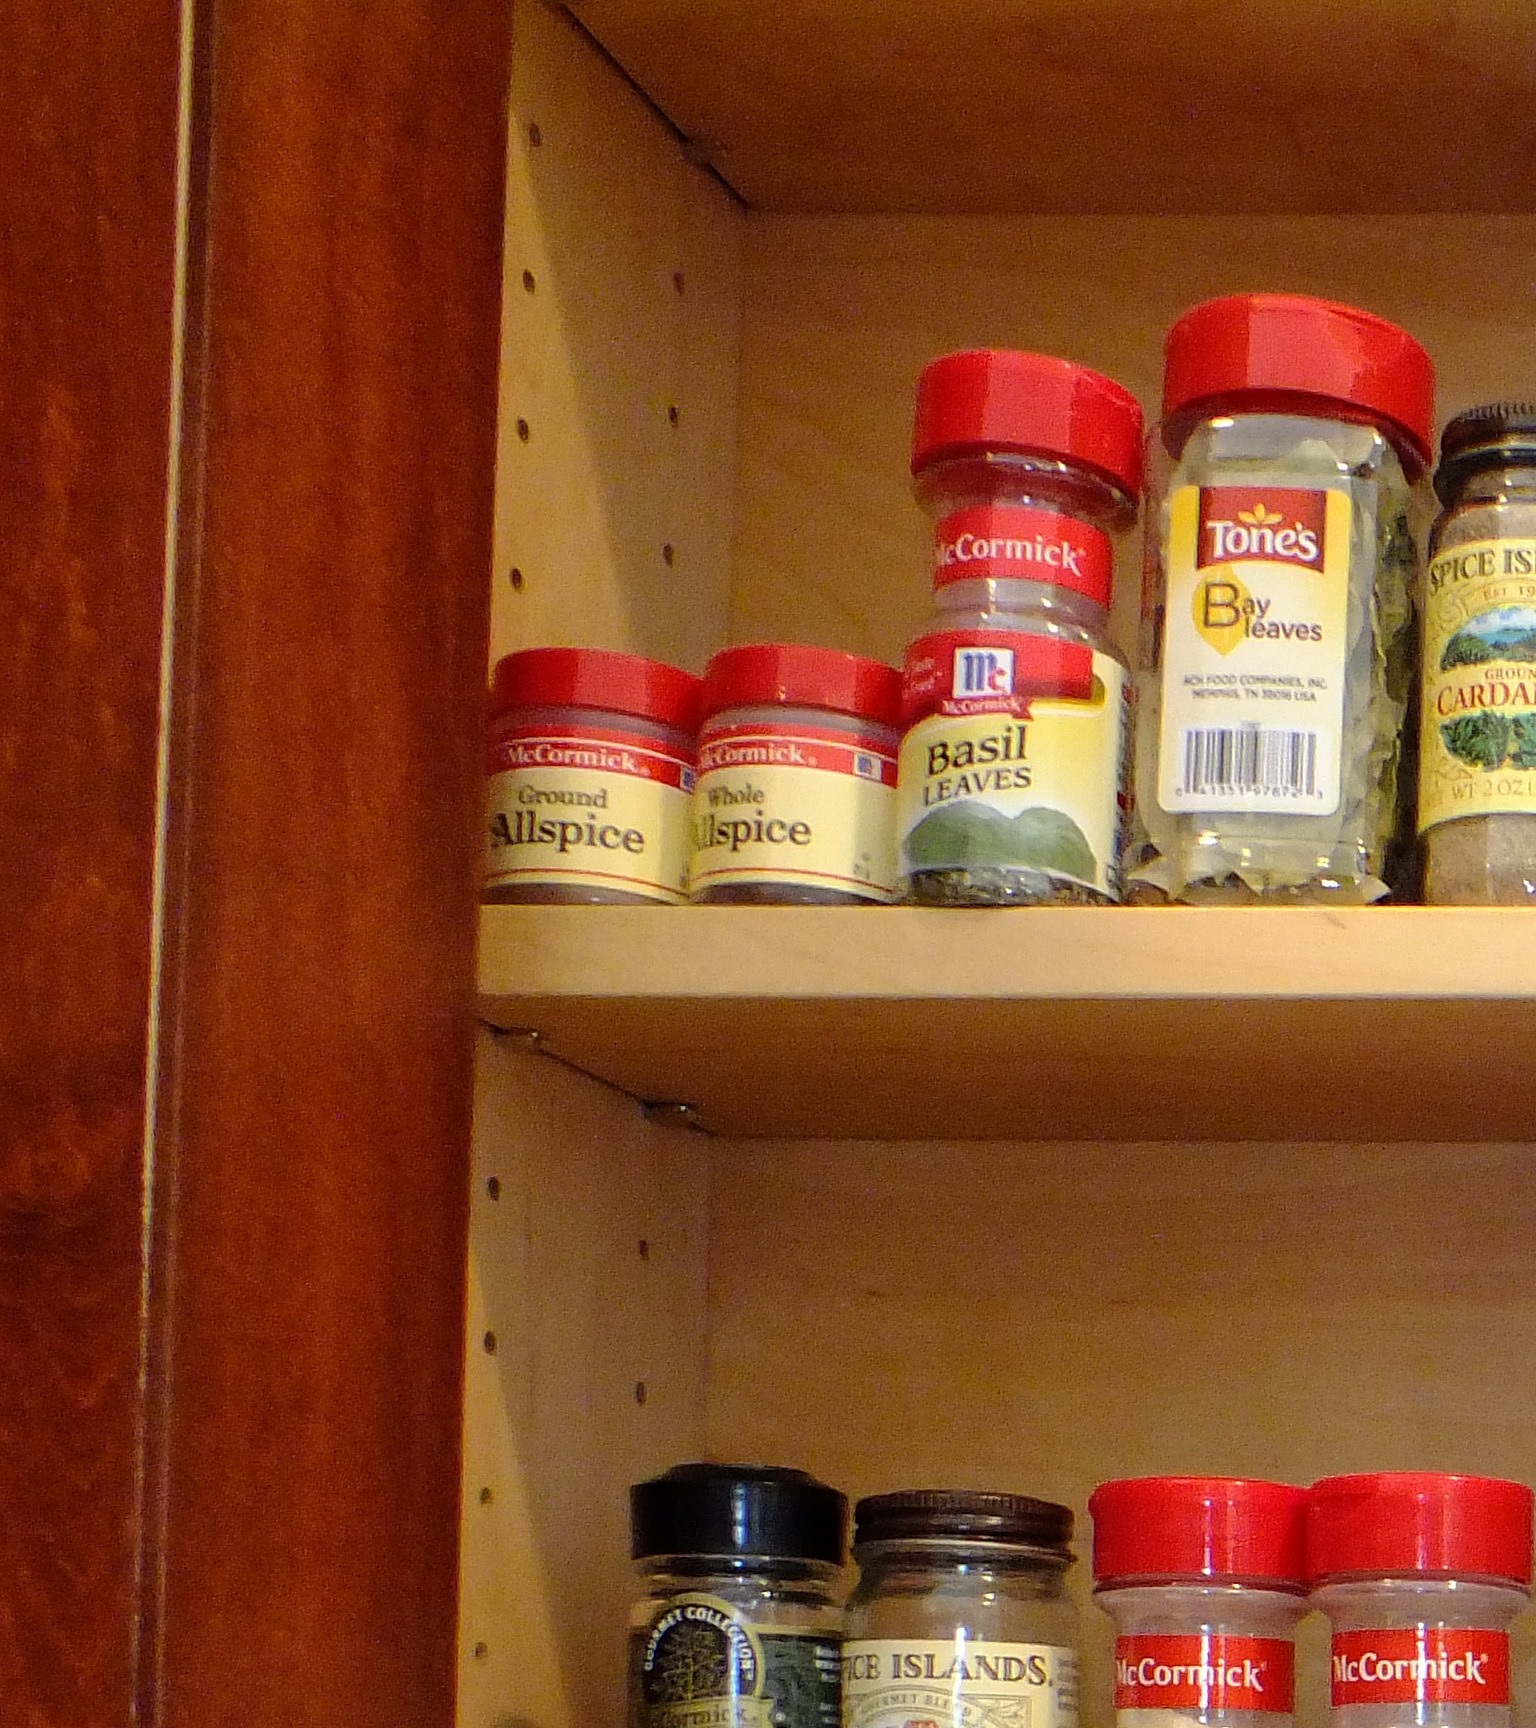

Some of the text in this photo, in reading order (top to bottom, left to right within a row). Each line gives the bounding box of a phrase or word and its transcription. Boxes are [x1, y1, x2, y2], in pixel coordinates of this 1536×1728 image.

[1206, 521, 1319, 563] Tone's
[1428, 550, 1497, 596] SPICE
[1203, 582, 1271, 629] Bay
[1244, 615, 1323, 642] leaves
[927, 725, 1029, 777] Basil
[518, 785, 609, 809] Ground
[922, 766, 1033, 807] LEAVES
[490, 810, 646, 853] Allspice
